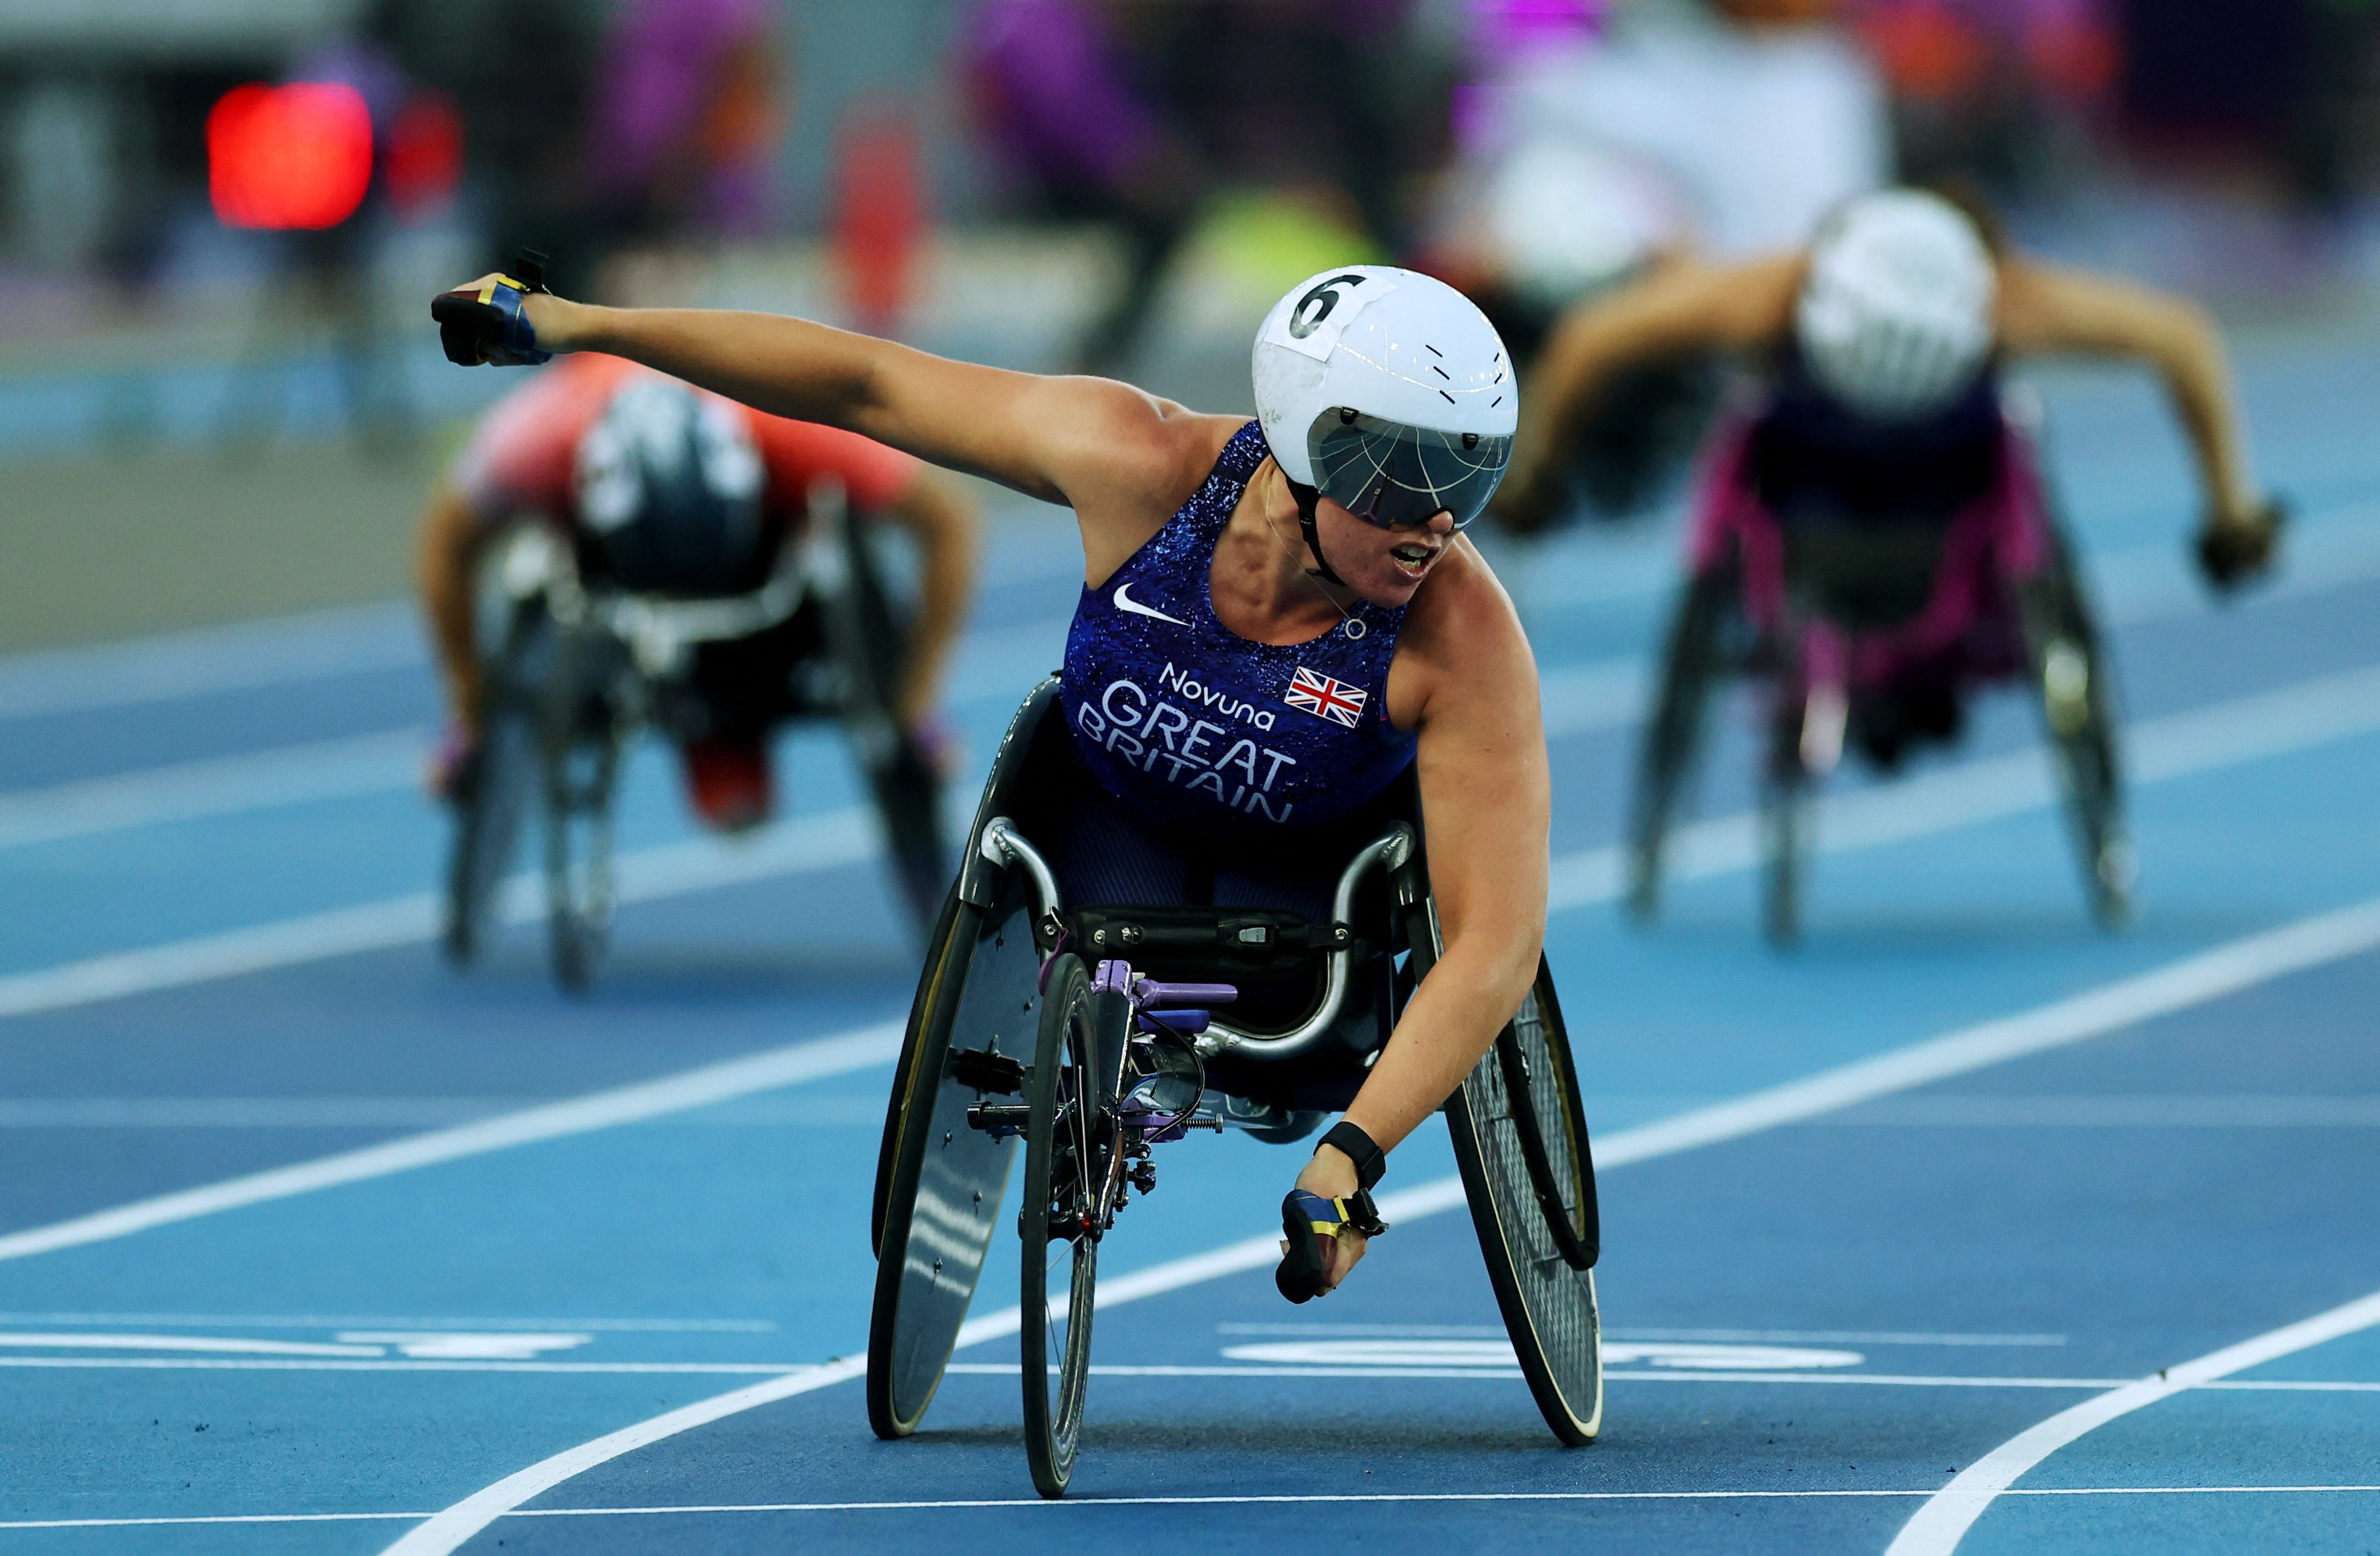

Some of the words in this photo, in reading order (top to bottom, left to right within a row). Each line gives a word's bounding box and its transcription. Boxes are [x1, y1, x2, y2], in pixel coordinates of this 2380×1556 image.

[1289, 274, 1367, 339] 6
[1102, 680, 1296, 792] GREAT
[1159, 661, 1276, 732] Novuna
[1078, 701, 1293, 823] BRITAIN
